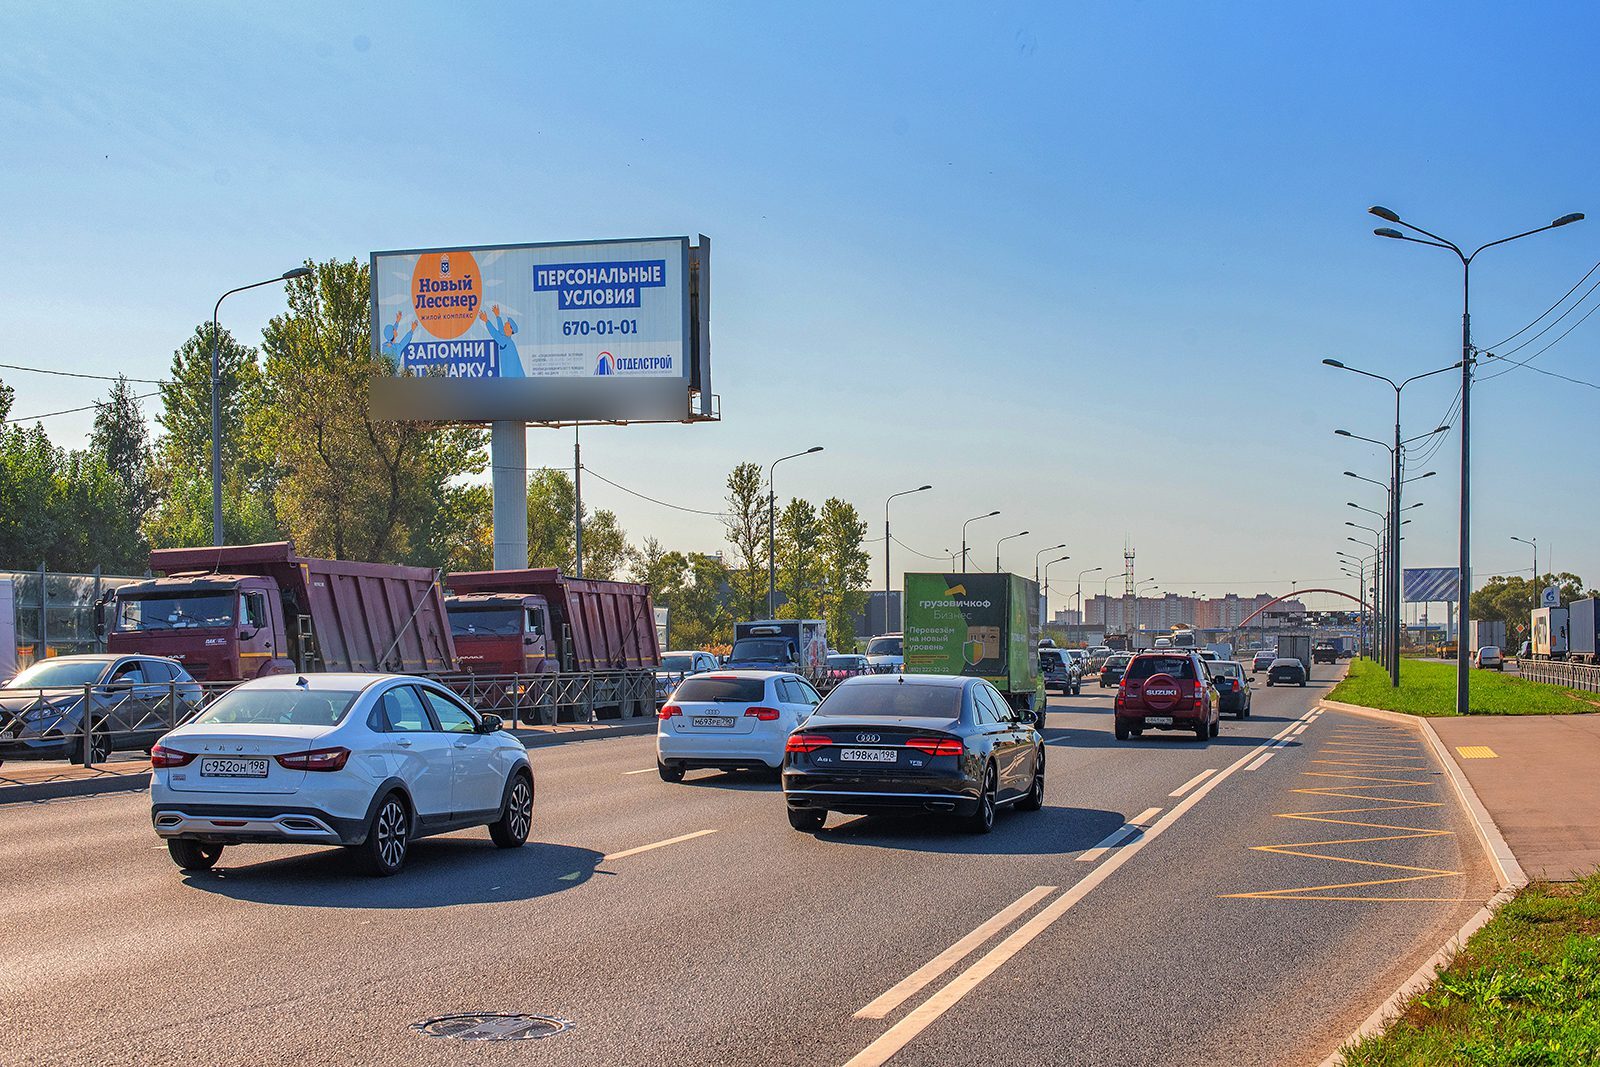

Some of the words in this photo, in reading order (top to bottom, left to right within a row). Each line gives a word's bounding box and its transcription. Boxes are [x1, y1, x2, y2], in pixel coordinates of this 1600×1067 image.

[418, 275, 473, 293] Новый
[537, 266, 661, 286] ПЕРСОНАЛЬНЫЕ
[415, 294, 478, 311] Лесснер
[562, 288, 635, 306] УСЛОВИЯ
[562, 319, 638, 336] 670-01-01
[407, 342, 485, 360] ЗАПОМНИ
[616, 354, 673, 370] ОТДЕЛСТРОЙ
[919, 599, 991, 609] грузовичкоф
[933, 610, 973, 620] Бизнес
[921, 634, 949, 642] новый
[909, 644, 945, 652] уровень
